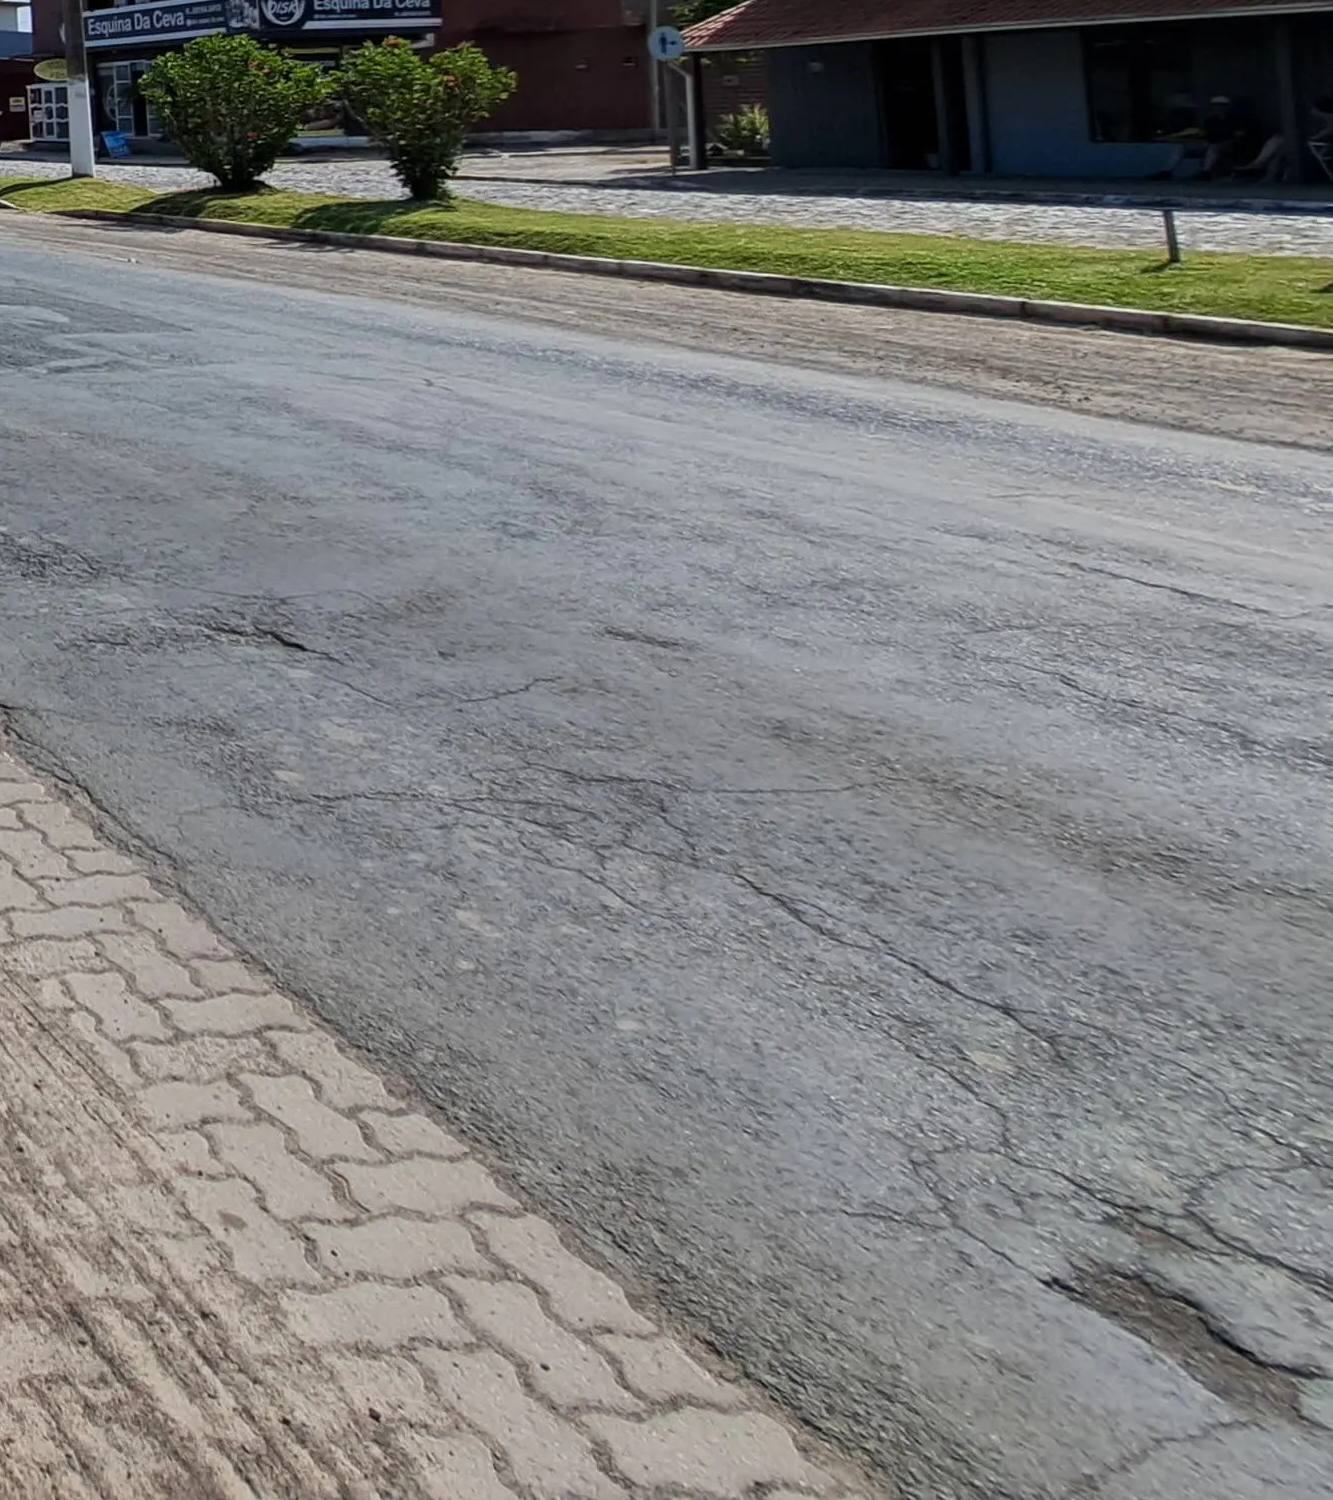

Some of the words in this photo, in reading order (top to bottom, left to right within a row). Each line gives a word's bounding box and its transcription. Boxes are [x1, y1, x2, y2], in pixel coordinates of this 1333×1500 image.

[88, 15, 132, 38] Esquina
[134, 13, 151, 31] Da
[153, 10, 184, 29] Ceva
